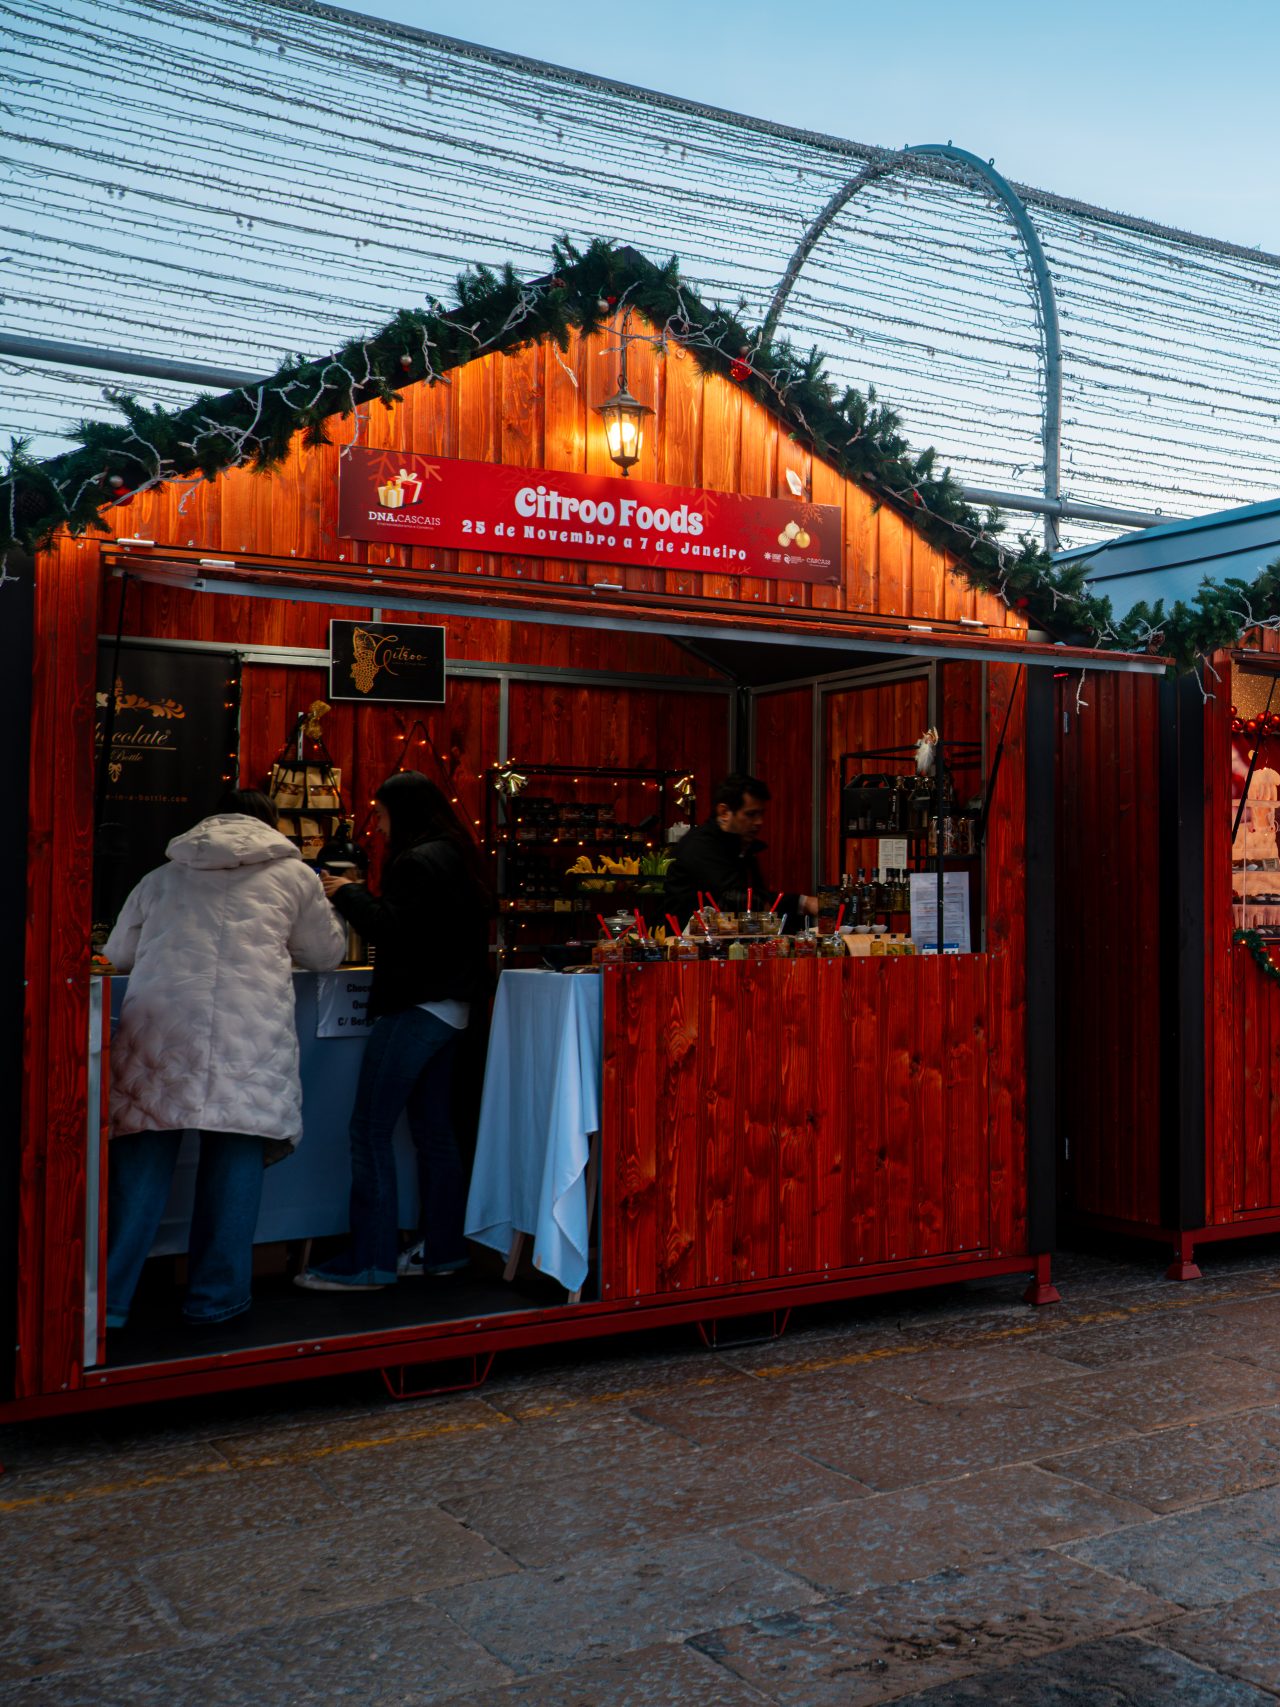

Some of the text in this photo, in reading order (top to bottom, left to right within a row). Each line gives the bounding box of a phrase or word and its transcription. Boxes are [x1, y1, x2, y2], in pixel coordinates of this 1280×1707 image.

[515, 485, 704, 536] Citroo Foods
[462, 519, 747, 561] 25 de Novembro a 7 de Janeiro
